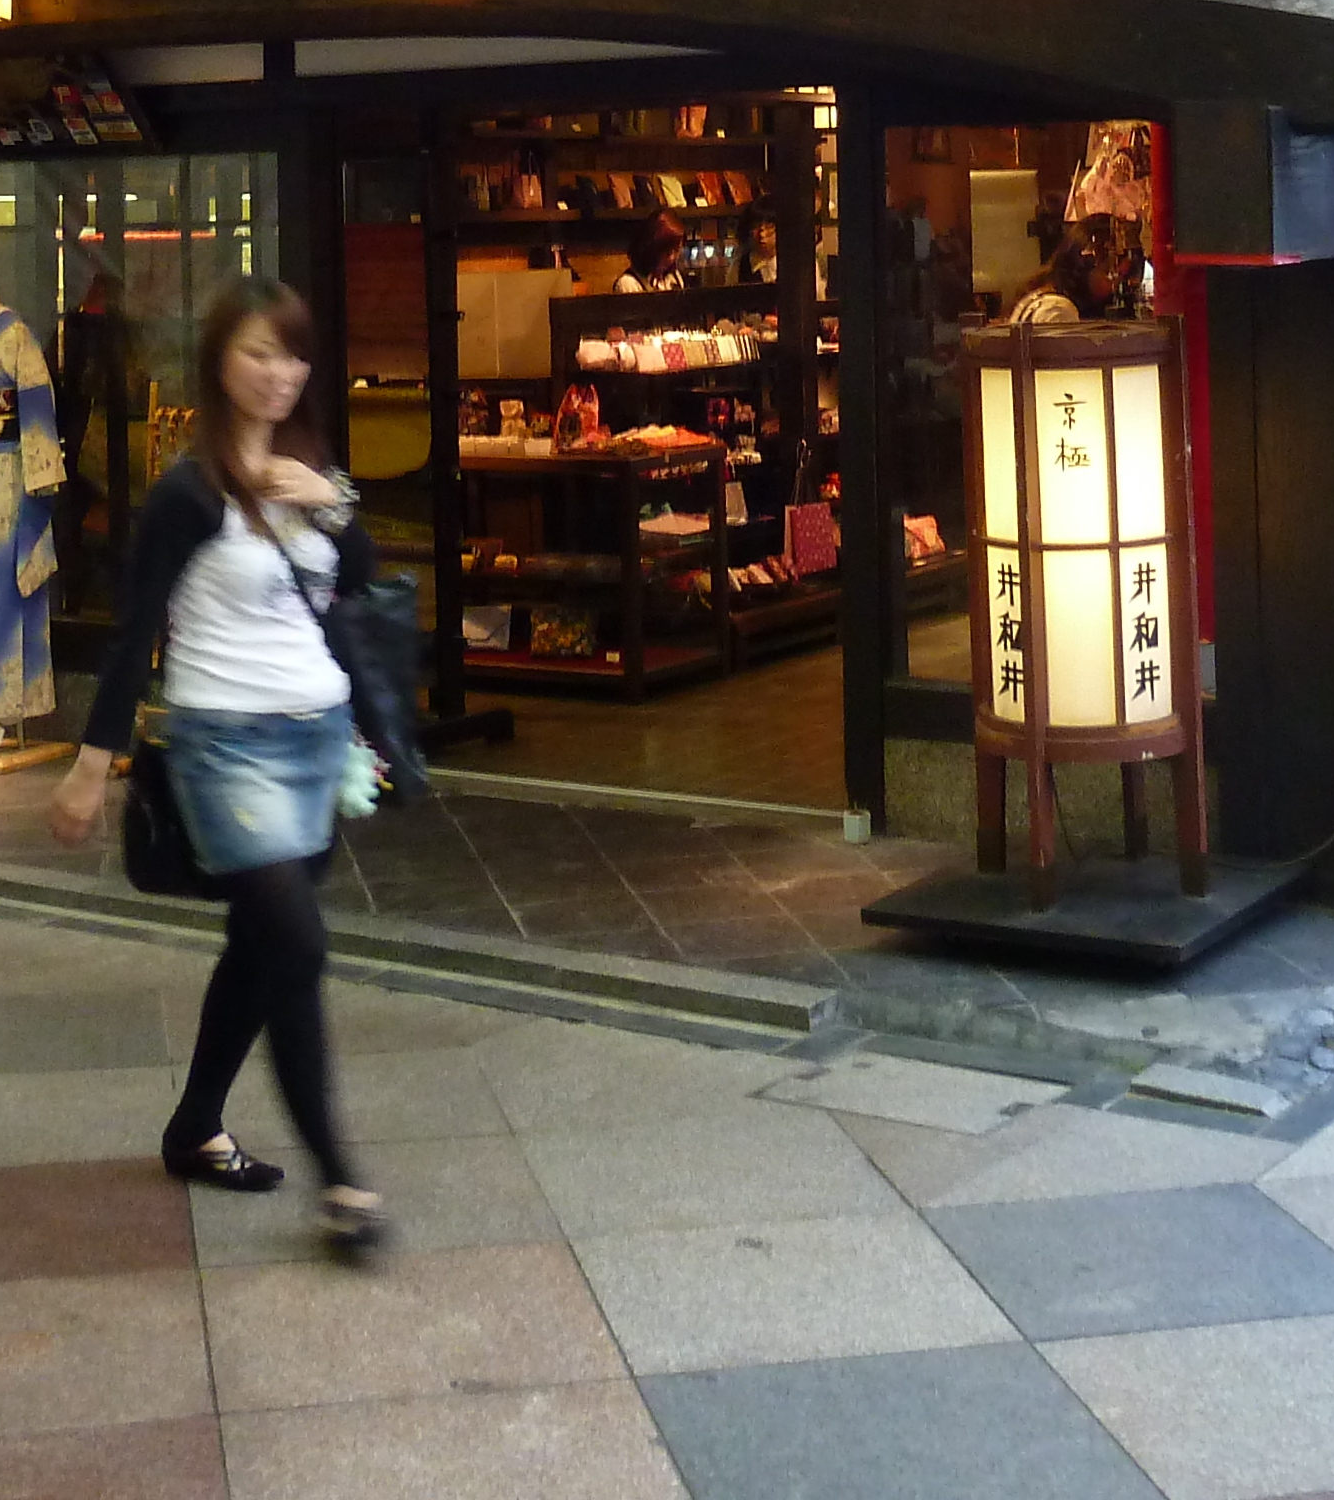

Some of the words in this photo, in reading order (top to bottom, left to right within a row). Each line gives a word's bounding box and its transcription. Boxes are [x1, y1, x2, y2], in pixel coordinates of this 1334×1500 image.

[1052, 392, 1091, 473] 京極
[995, 561, 1025, 704] 井和井
[1129, 561, 1162, 702] 井和井
